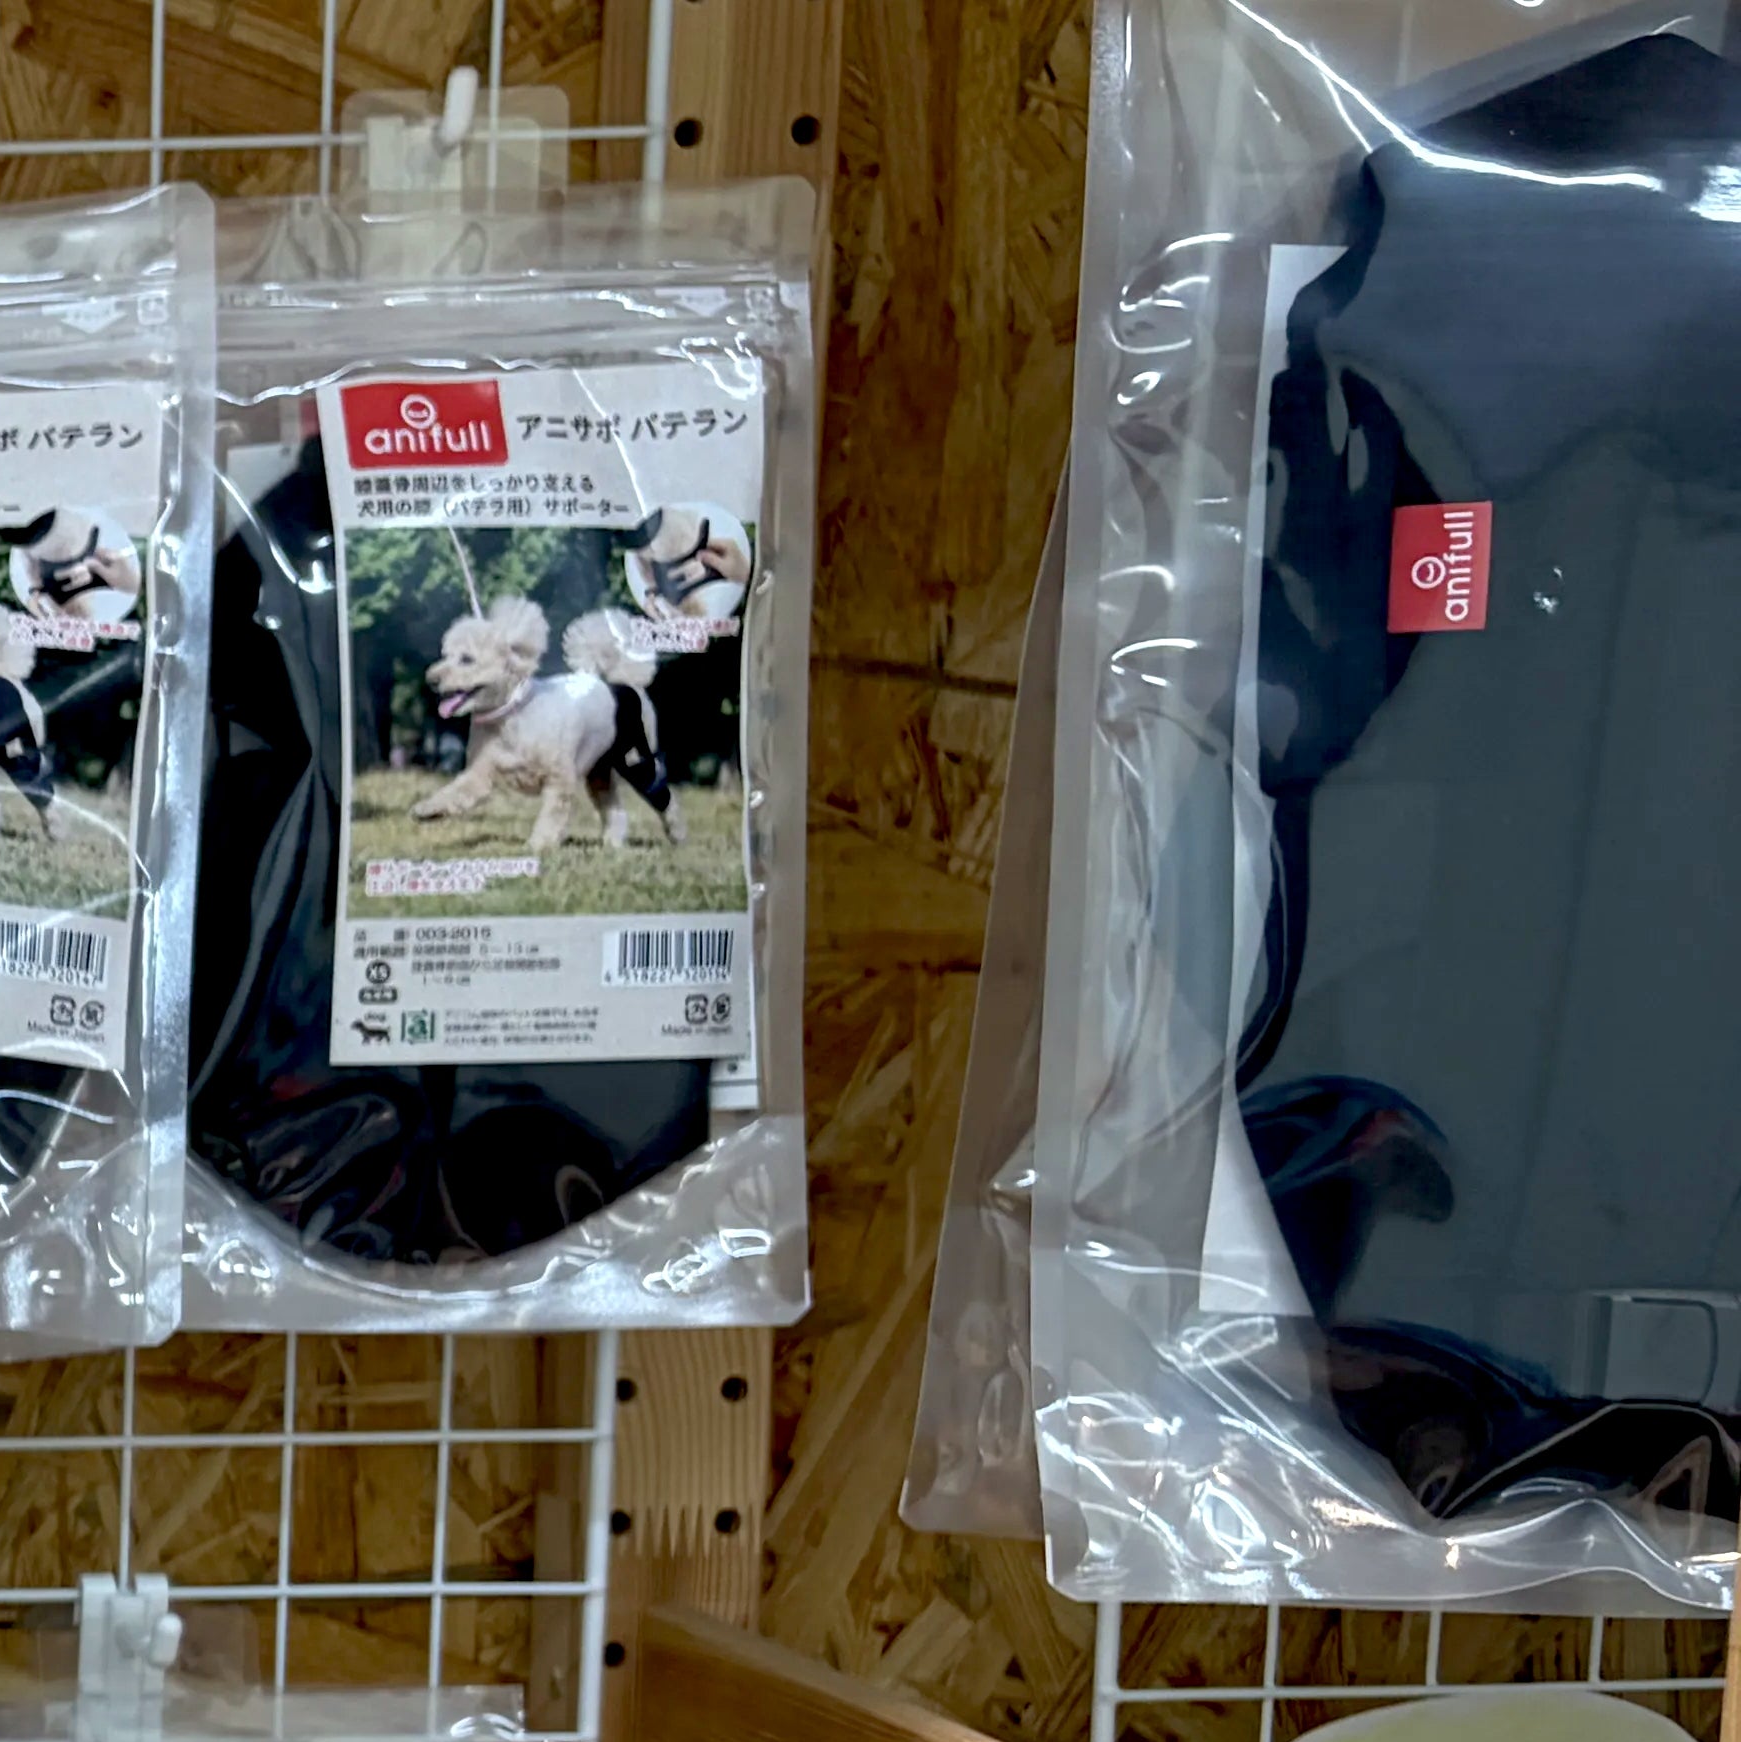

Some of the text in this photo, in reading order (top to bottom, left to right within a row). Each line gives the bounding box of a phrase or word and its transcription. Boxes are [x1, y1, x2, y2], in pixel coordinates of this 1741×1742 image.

[363, 421, 491, 455] anifull
[517, 413, 622, 445] アニサポ
[1442, 511, 1475, 622] anifull
